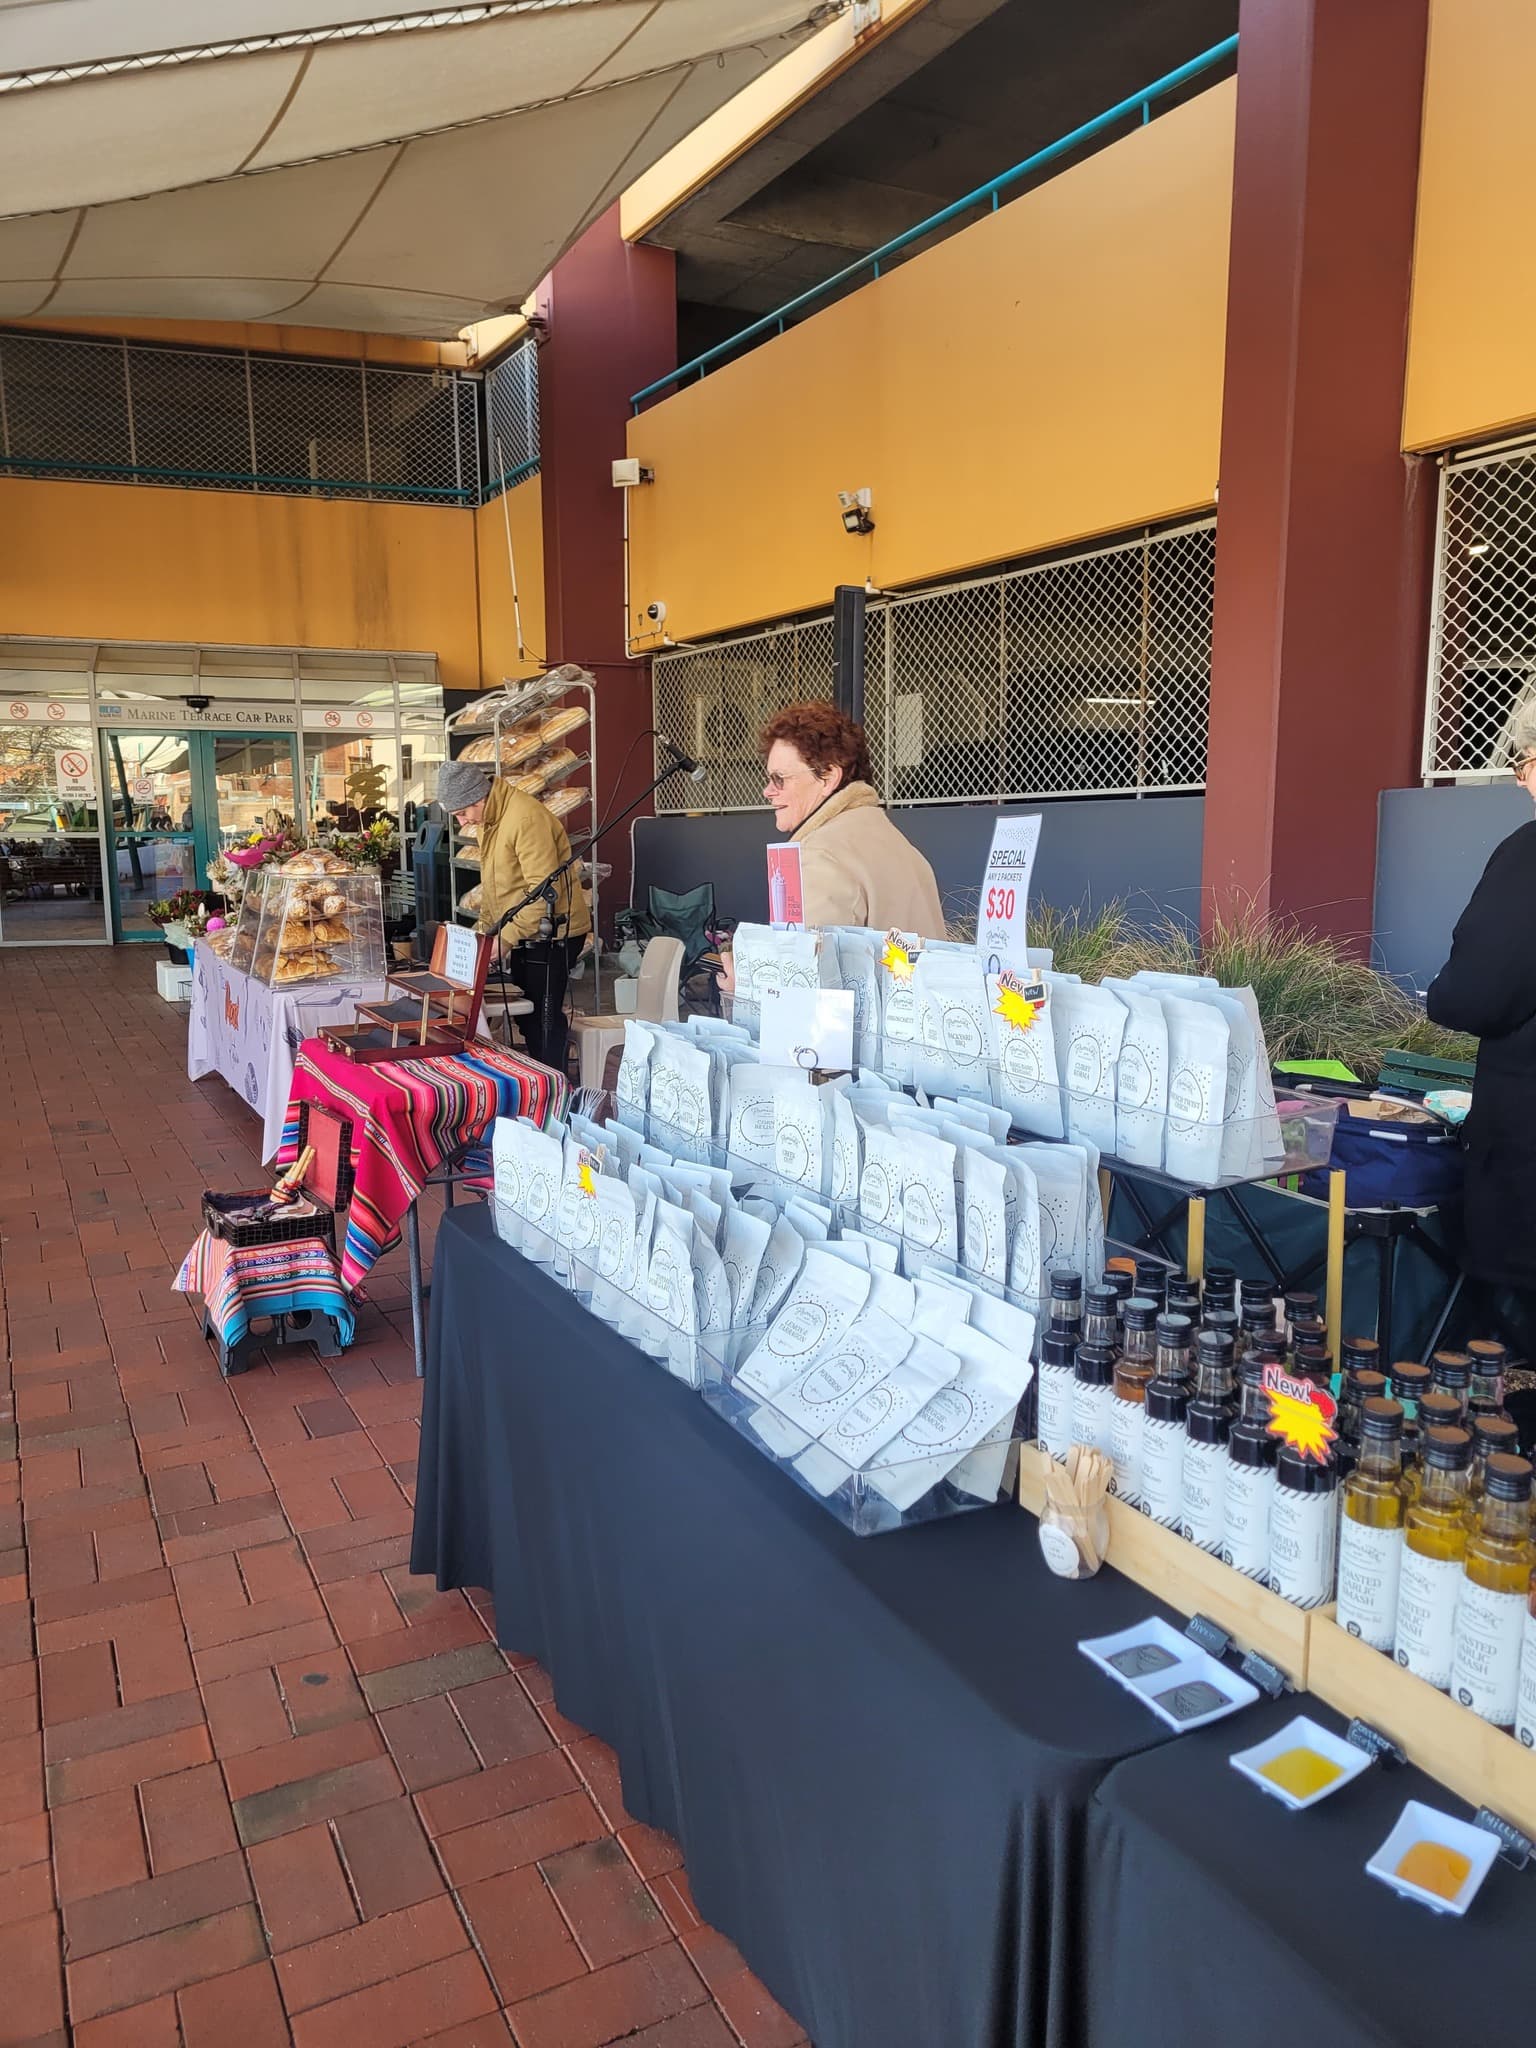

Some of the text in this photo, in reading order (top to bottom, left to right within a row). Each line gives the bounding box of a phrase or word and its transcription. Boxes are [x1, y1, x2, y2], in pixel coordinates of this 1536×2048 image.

[127, 708, 294, 724] MARINE TERRACE CAR PARK
[990, 850, 1027, 866] SPECIAL
[1001, 873, 1023, 882] PACKETS
[986, 886, 1015, 921] $30
[1266, 1367, 1312, 1404] New!
[925, 1407, 946, 1421] EGGIE
